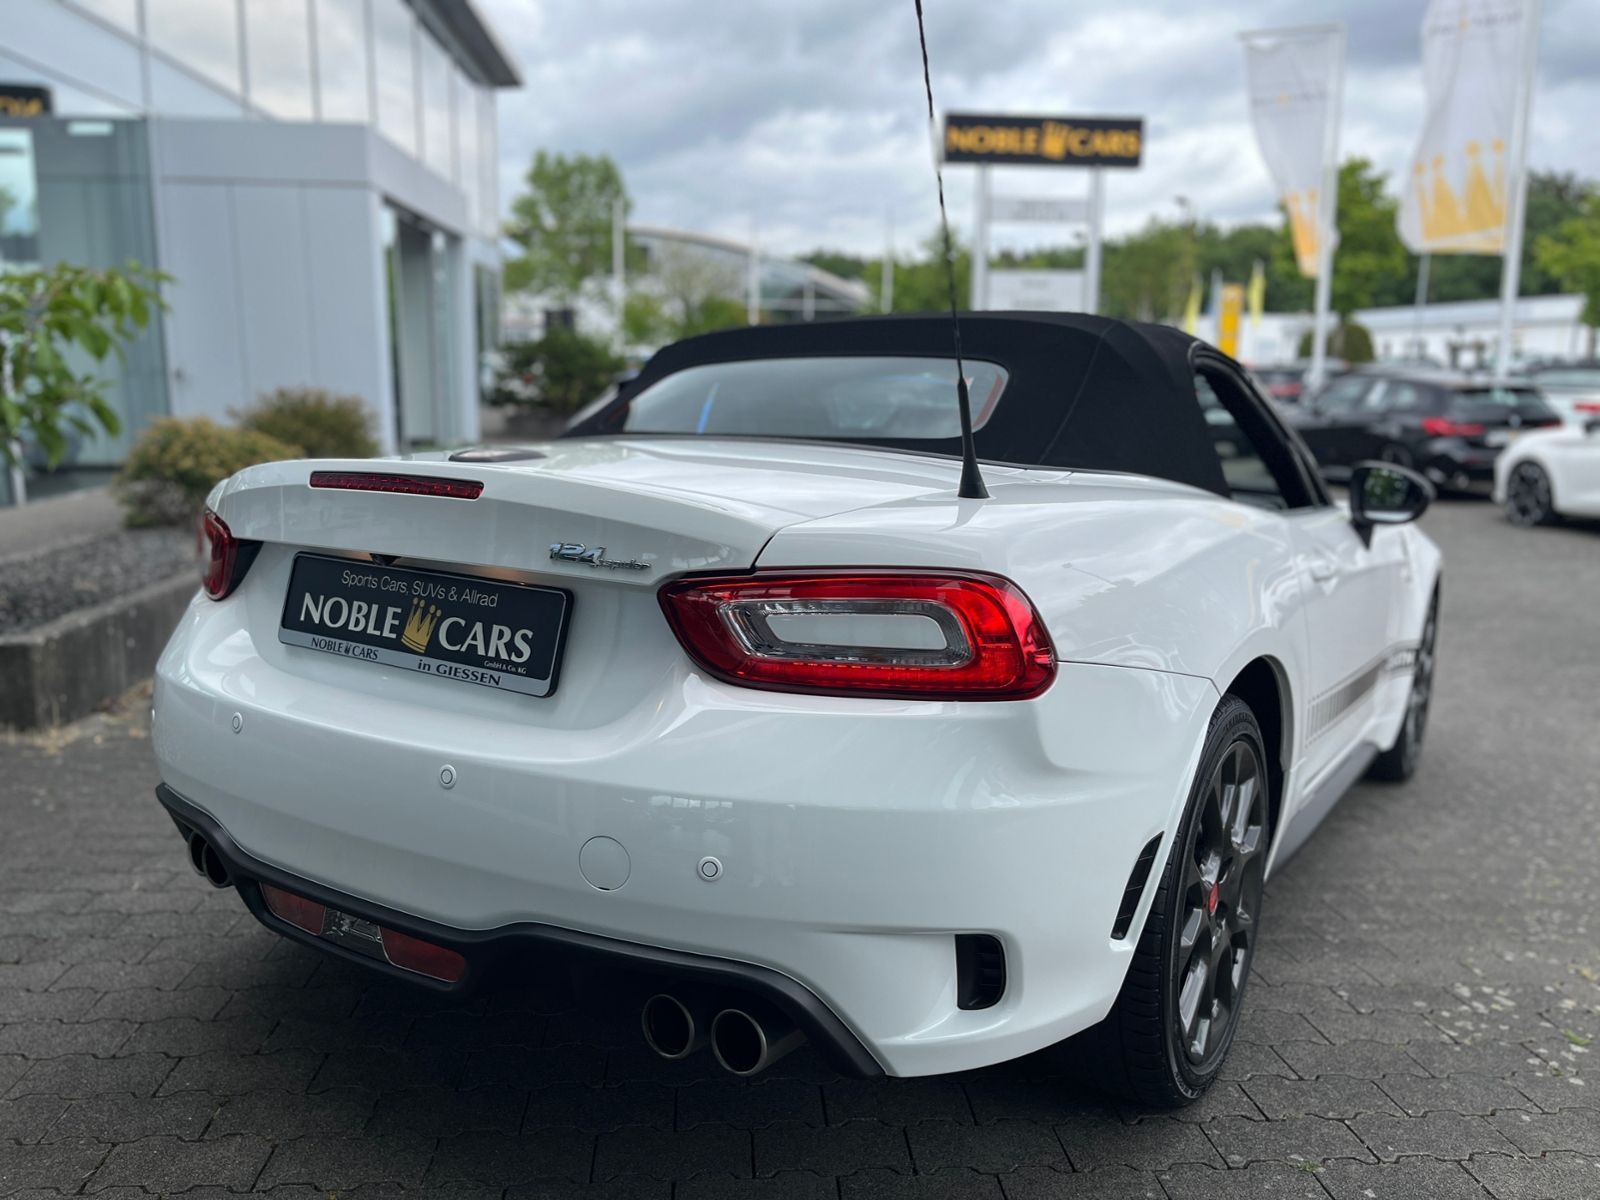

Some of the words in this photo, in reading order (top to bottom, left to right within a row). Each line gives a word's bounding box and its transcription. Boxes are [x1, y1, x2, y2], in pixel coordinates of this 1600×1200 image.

[549, 542, 606, 568] 124
[341, 570, 378, 590] Sports
[380, 576, 409, 595] Cars,
[411, 580, 446, 600] SUVs
[448, 587, 458, 602] &
[460, 589, 499, 608] Allrad
[300, 592, 402, 639] NOBLE
[438, 617, 534, 663] CARS
[311, 636, 343, 653] NOBLE
[352, 645, 379, 660] CARS
[418, 659, 431, 672] in
[436, 663, 501, 686] GIESSEN
[484, 660, 502, 670] GmbH
[517, 666, 527, 675] KG
